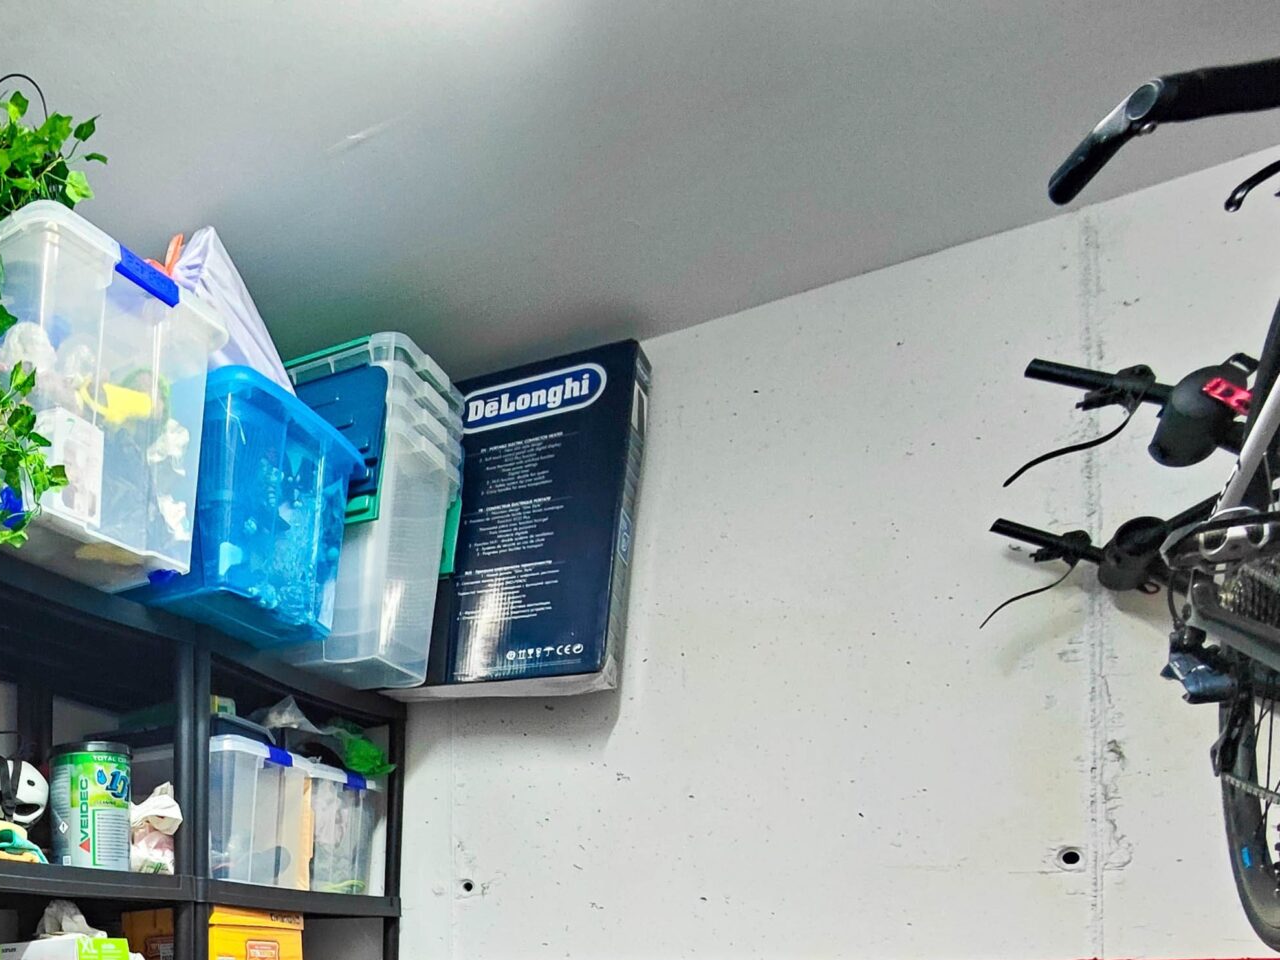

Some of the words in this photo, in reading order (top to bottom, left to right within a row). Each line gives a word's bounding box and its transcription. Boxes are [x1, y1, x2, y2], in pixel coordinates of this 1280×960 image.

[93, 755, 116, 763] TOTAL
[79, 778, 89, 842] VEIDEC
[80, 937, 98, 954] XL
